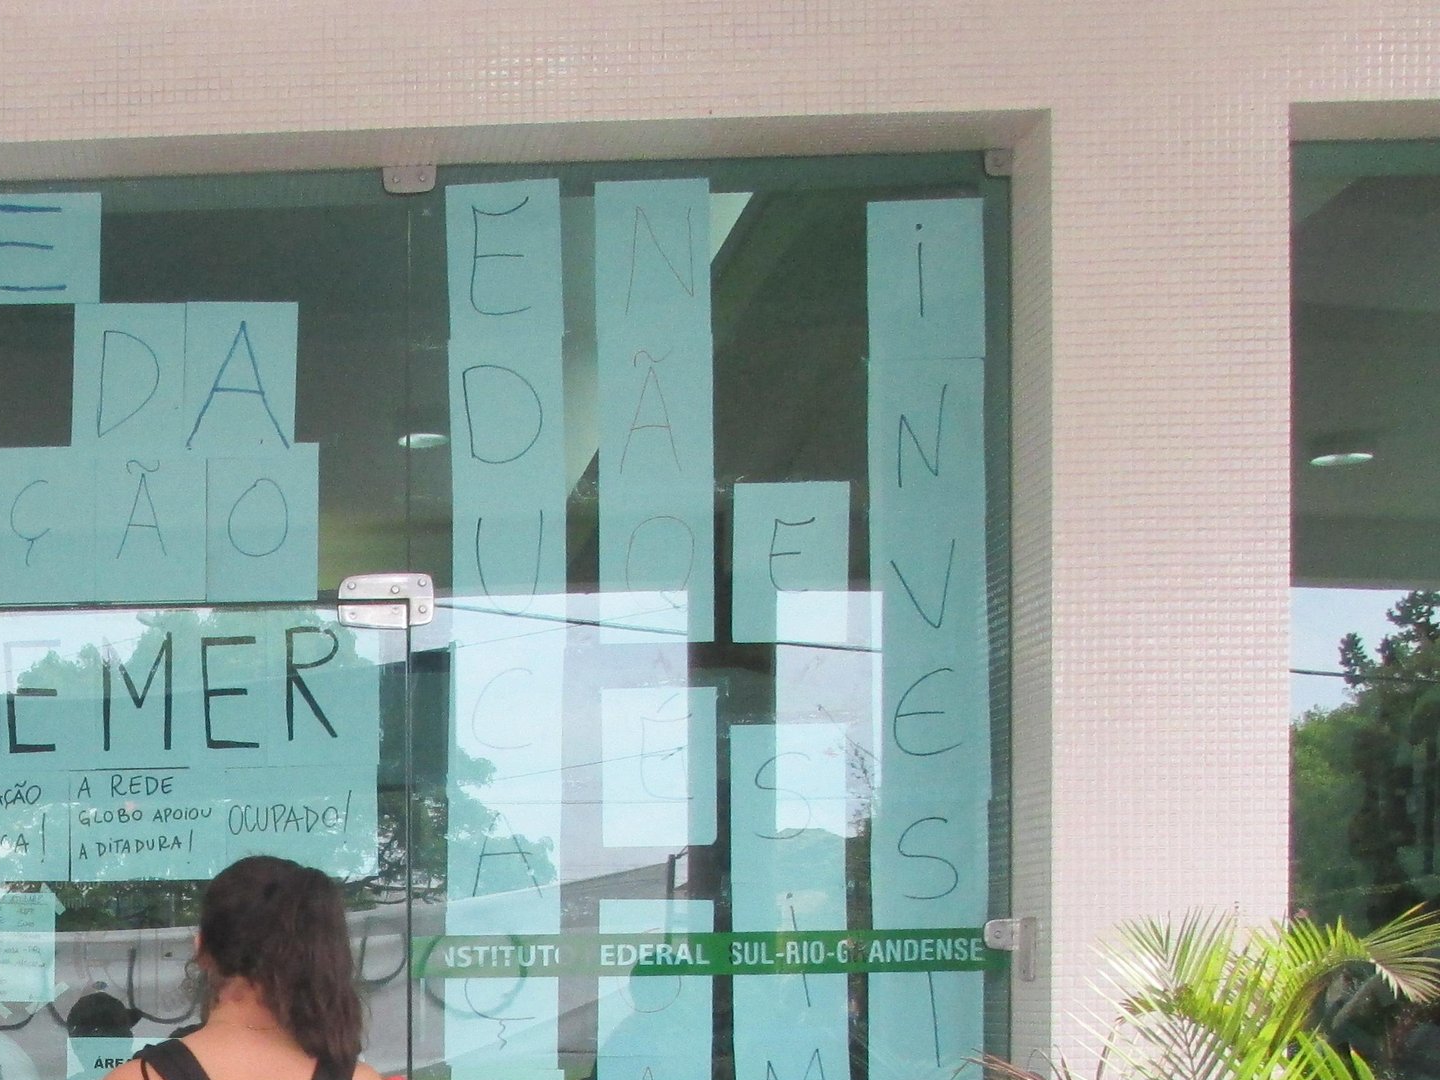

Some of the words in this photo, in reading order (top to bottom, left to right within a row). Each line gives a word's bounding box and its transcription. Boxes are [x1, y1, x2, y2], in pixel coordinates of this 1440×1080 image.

[96, 319, 291, 450] DA
[77, 776, 93, 798] A
[111, 773, 174, 797] REDE
[77, 807, 144, 827] GLOBO
[227, 789, 352, 844] OCUPADO!
[78, 842, 88, 860] A
[600, 942, 711, 967] EDERAL
[731, 938, 986, 966] SUL-RIO-GANDENSE
[93, 1056, 132, 1069] ÁRE
